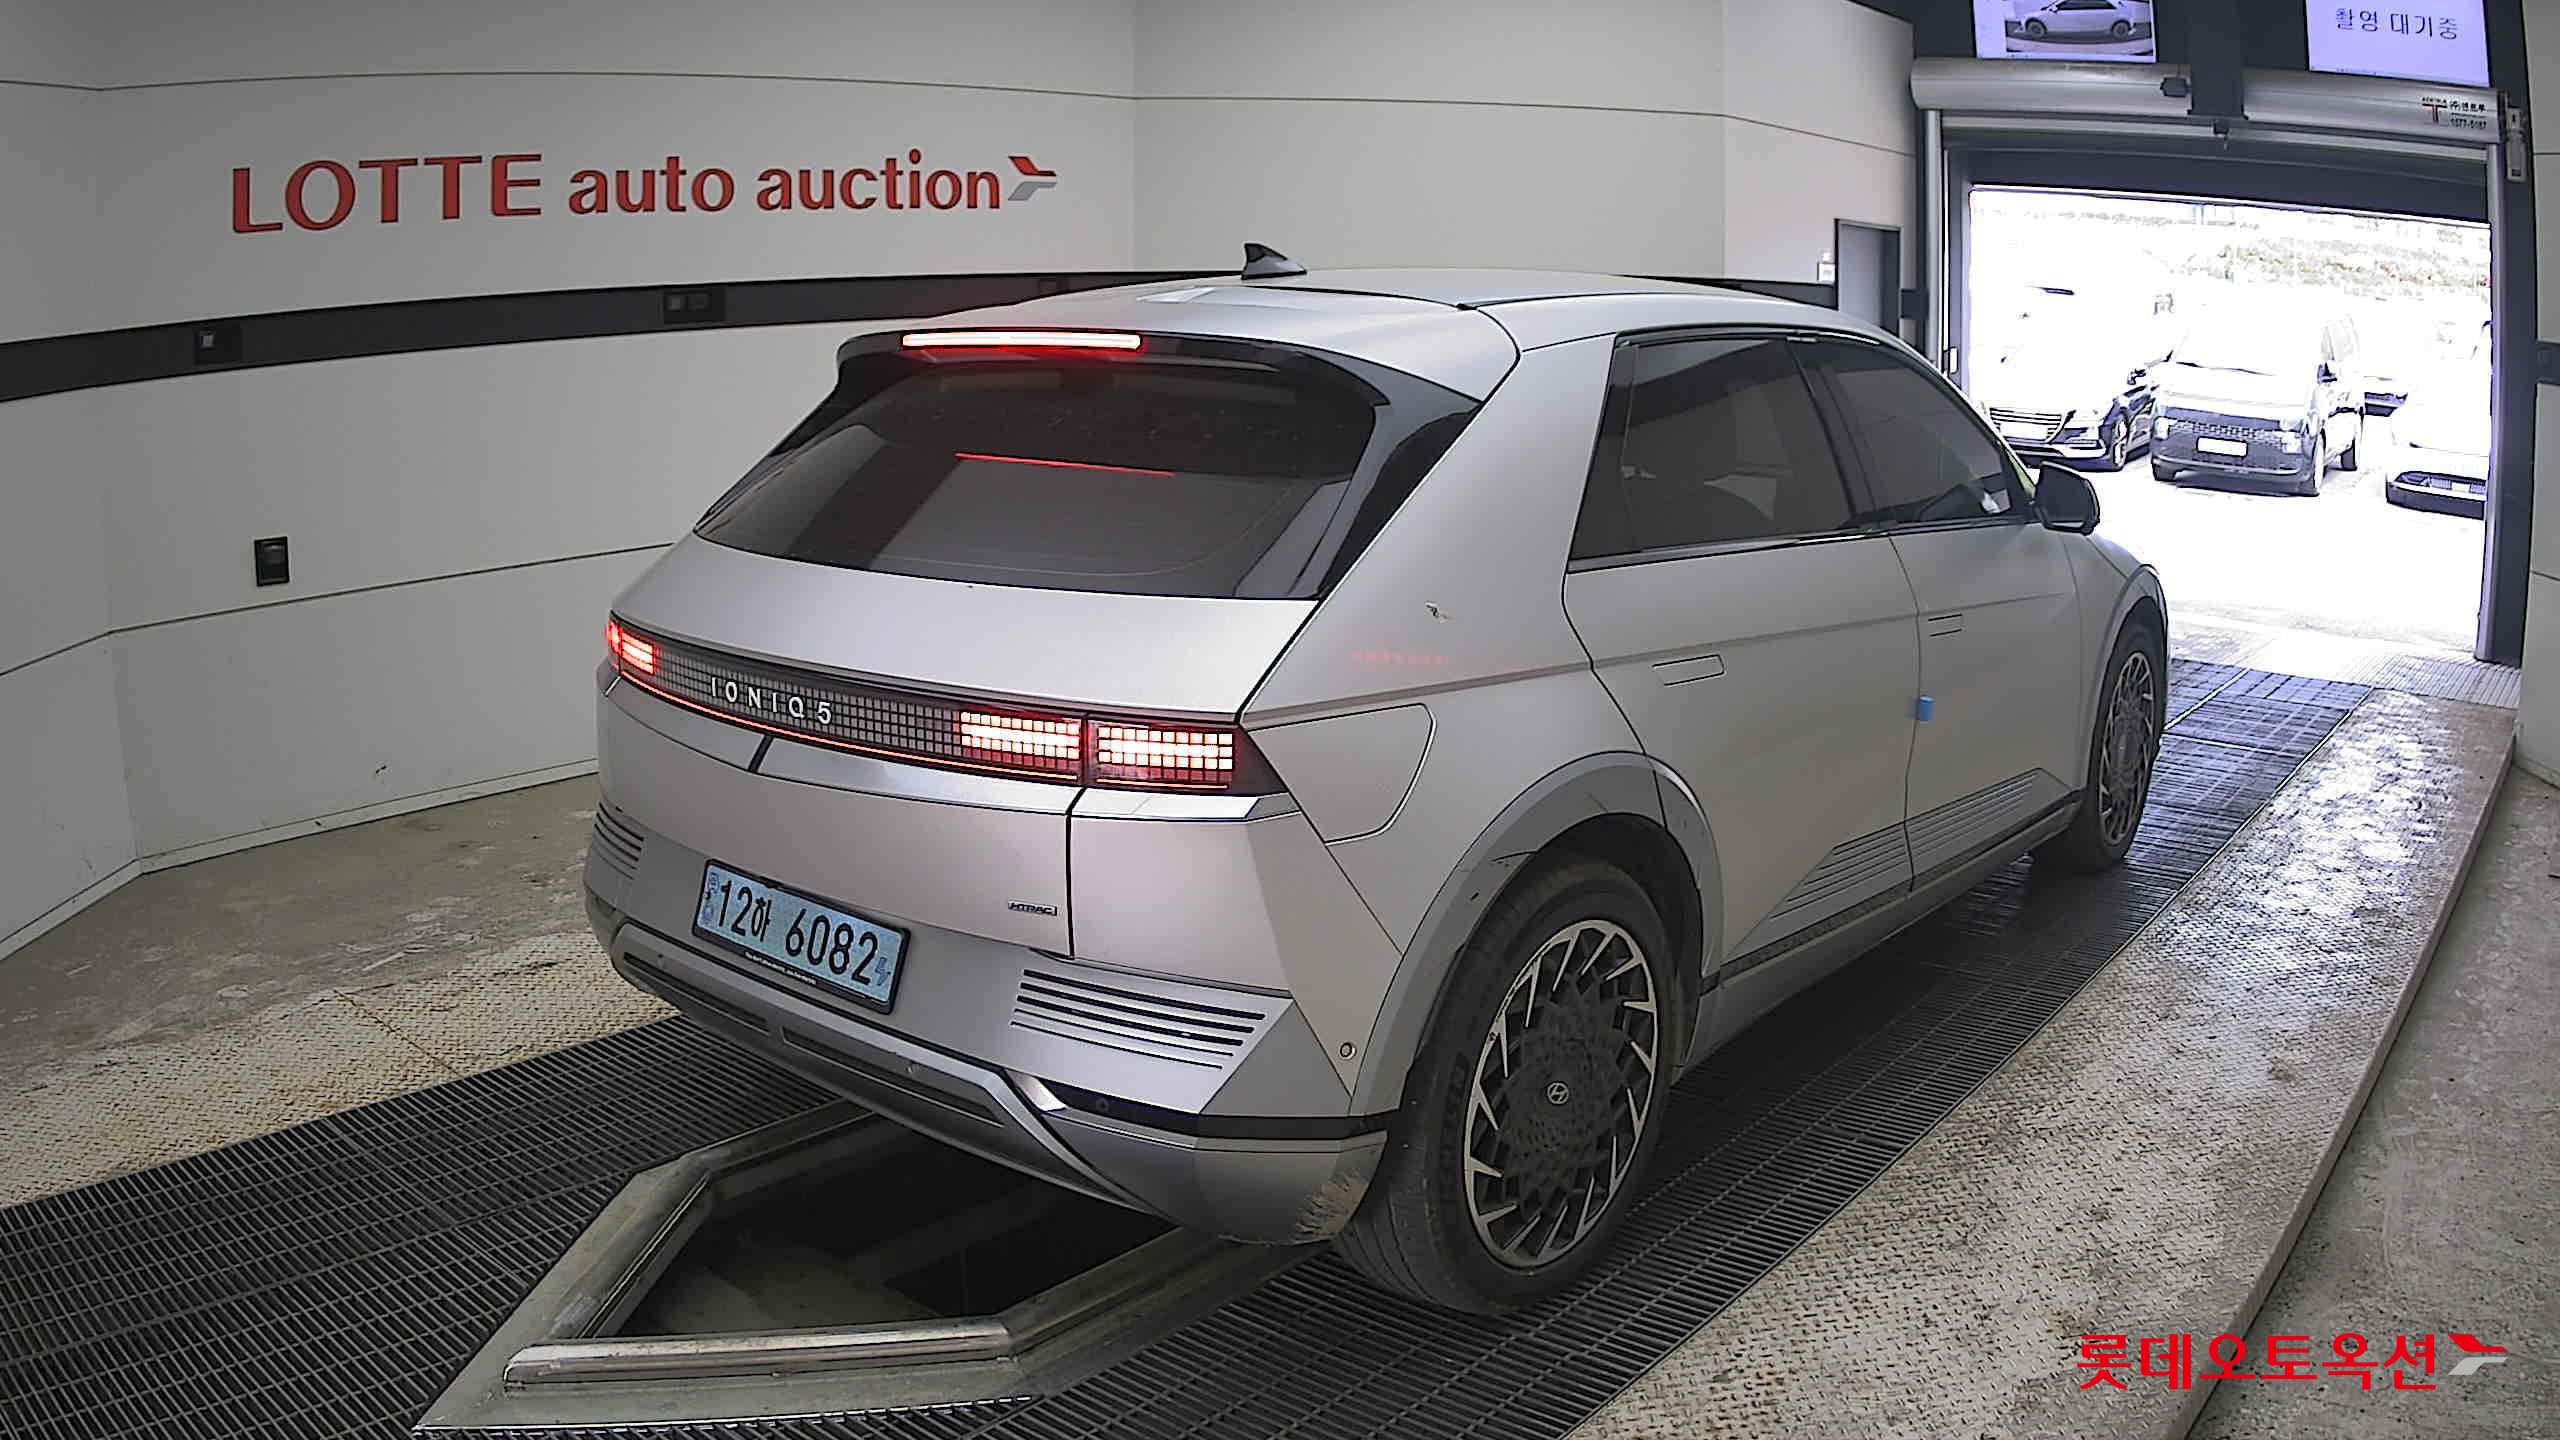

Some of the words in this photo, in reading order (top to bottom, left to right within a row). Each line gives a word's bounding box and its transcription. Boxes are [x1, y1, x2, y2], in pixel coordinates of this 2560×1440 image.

[2390, 13, 2459, 40] 대기중
[232, 153, 542, 235] LOTTE
[568, 156, 735, 214] auto
[756, 149, 1001, 210] auction
[711, 676, 805, 719] IONIQ
[816, 701, 833, 725] 5
[718, 880, 772, 943] 12하
[784, 908, 879, 986] 6082
